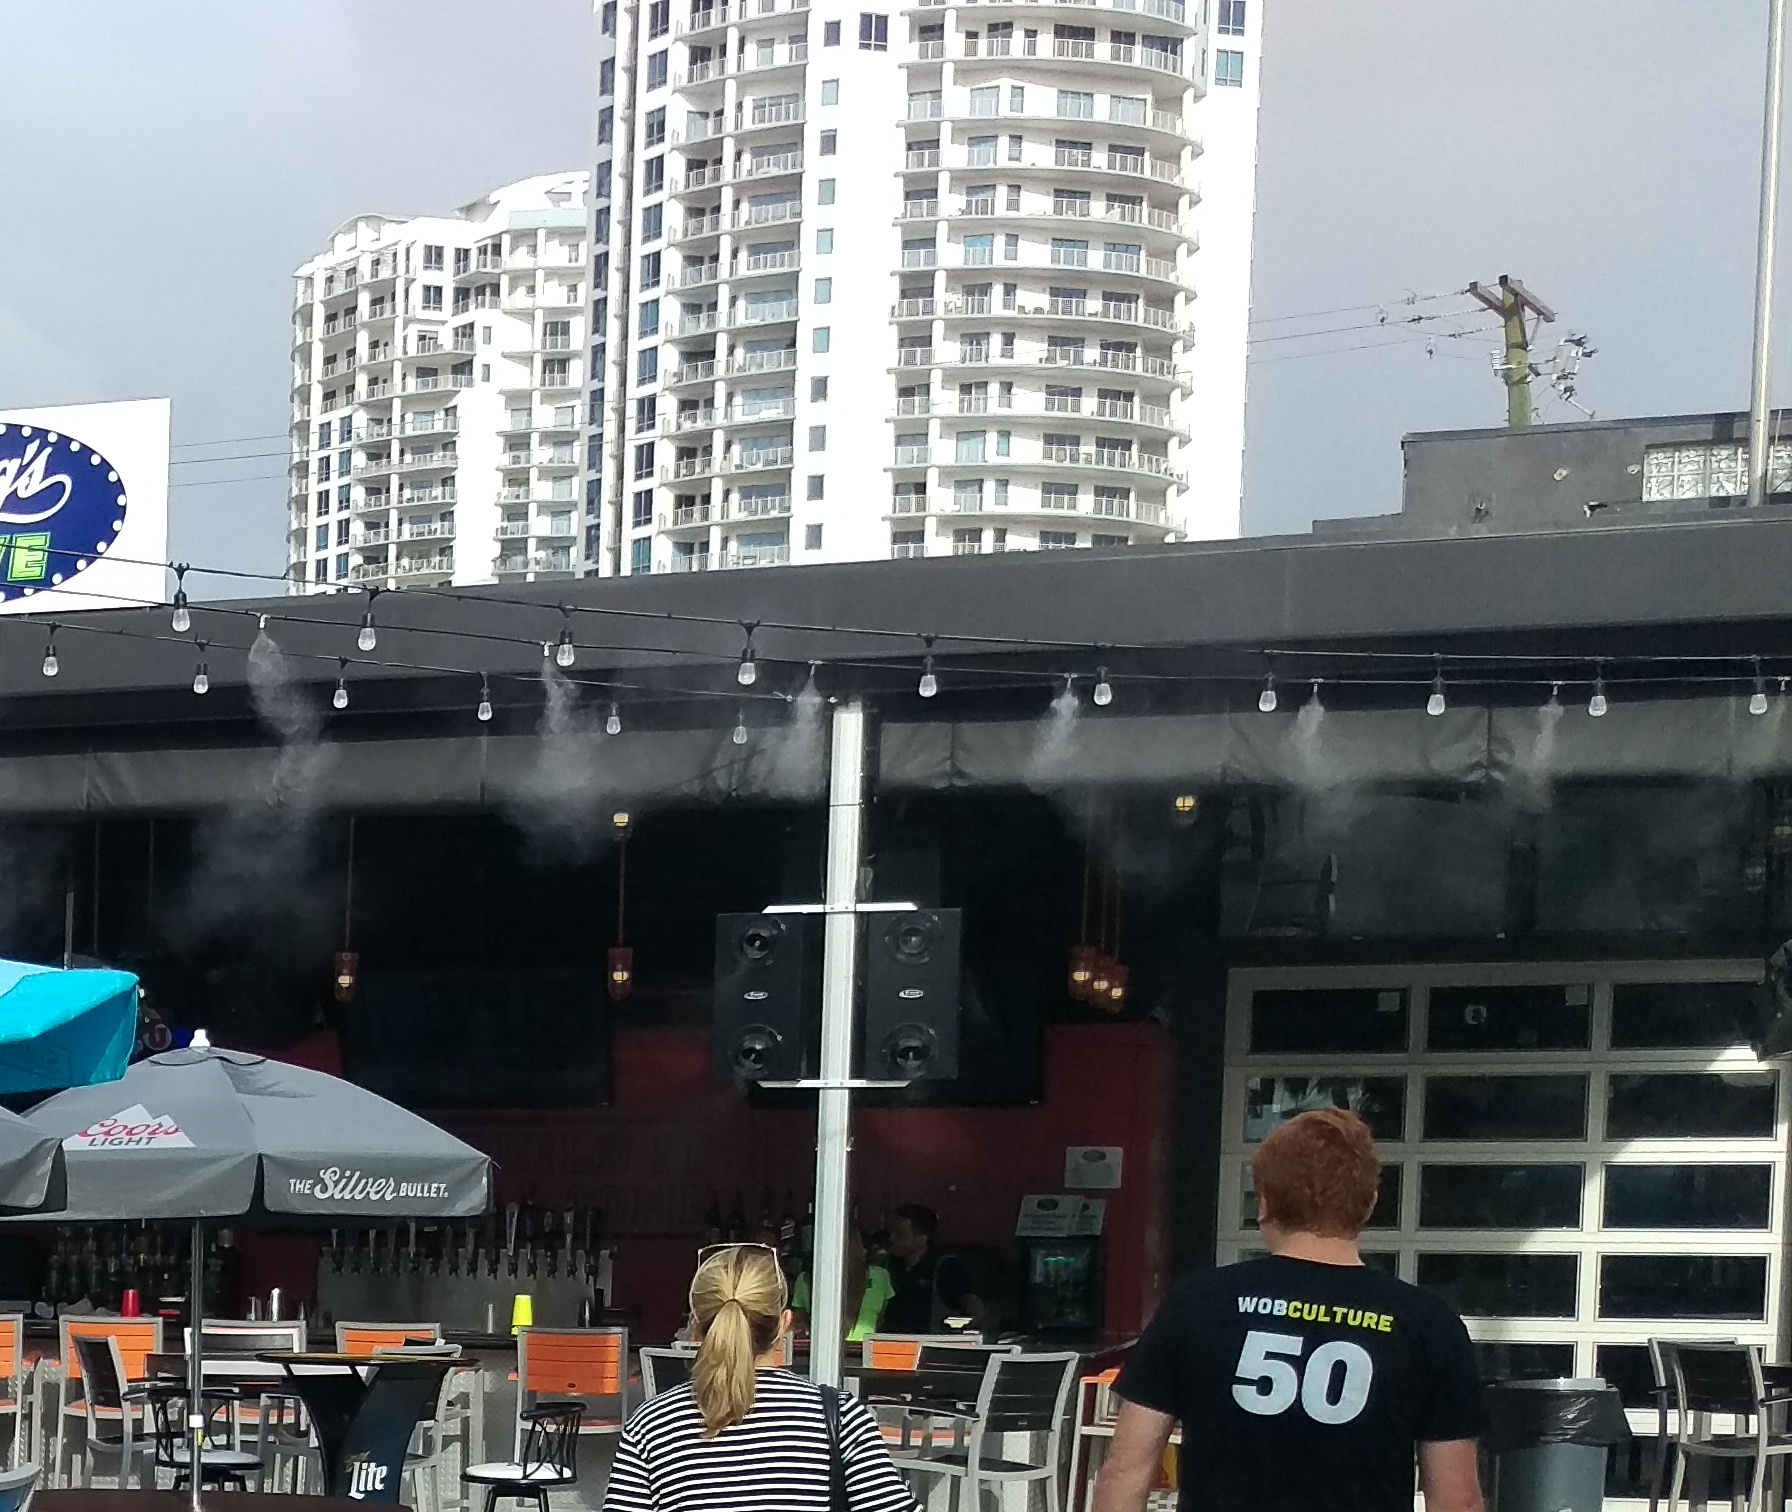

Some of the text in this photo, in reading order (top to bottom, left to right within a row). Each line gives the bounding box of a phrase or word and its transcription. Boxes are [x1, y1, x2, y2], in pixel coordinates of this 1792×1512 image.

[79, 1117, 182, 1138] Coors
[87, 1136, 159, 1148] LIGHT
[288, 1178, 314, 1194] THE
[314, 1166, 398, 1201] Silver
[1230, 1330, 1374, 1425] 50
[347, 1461, 388, 1500] Lite
